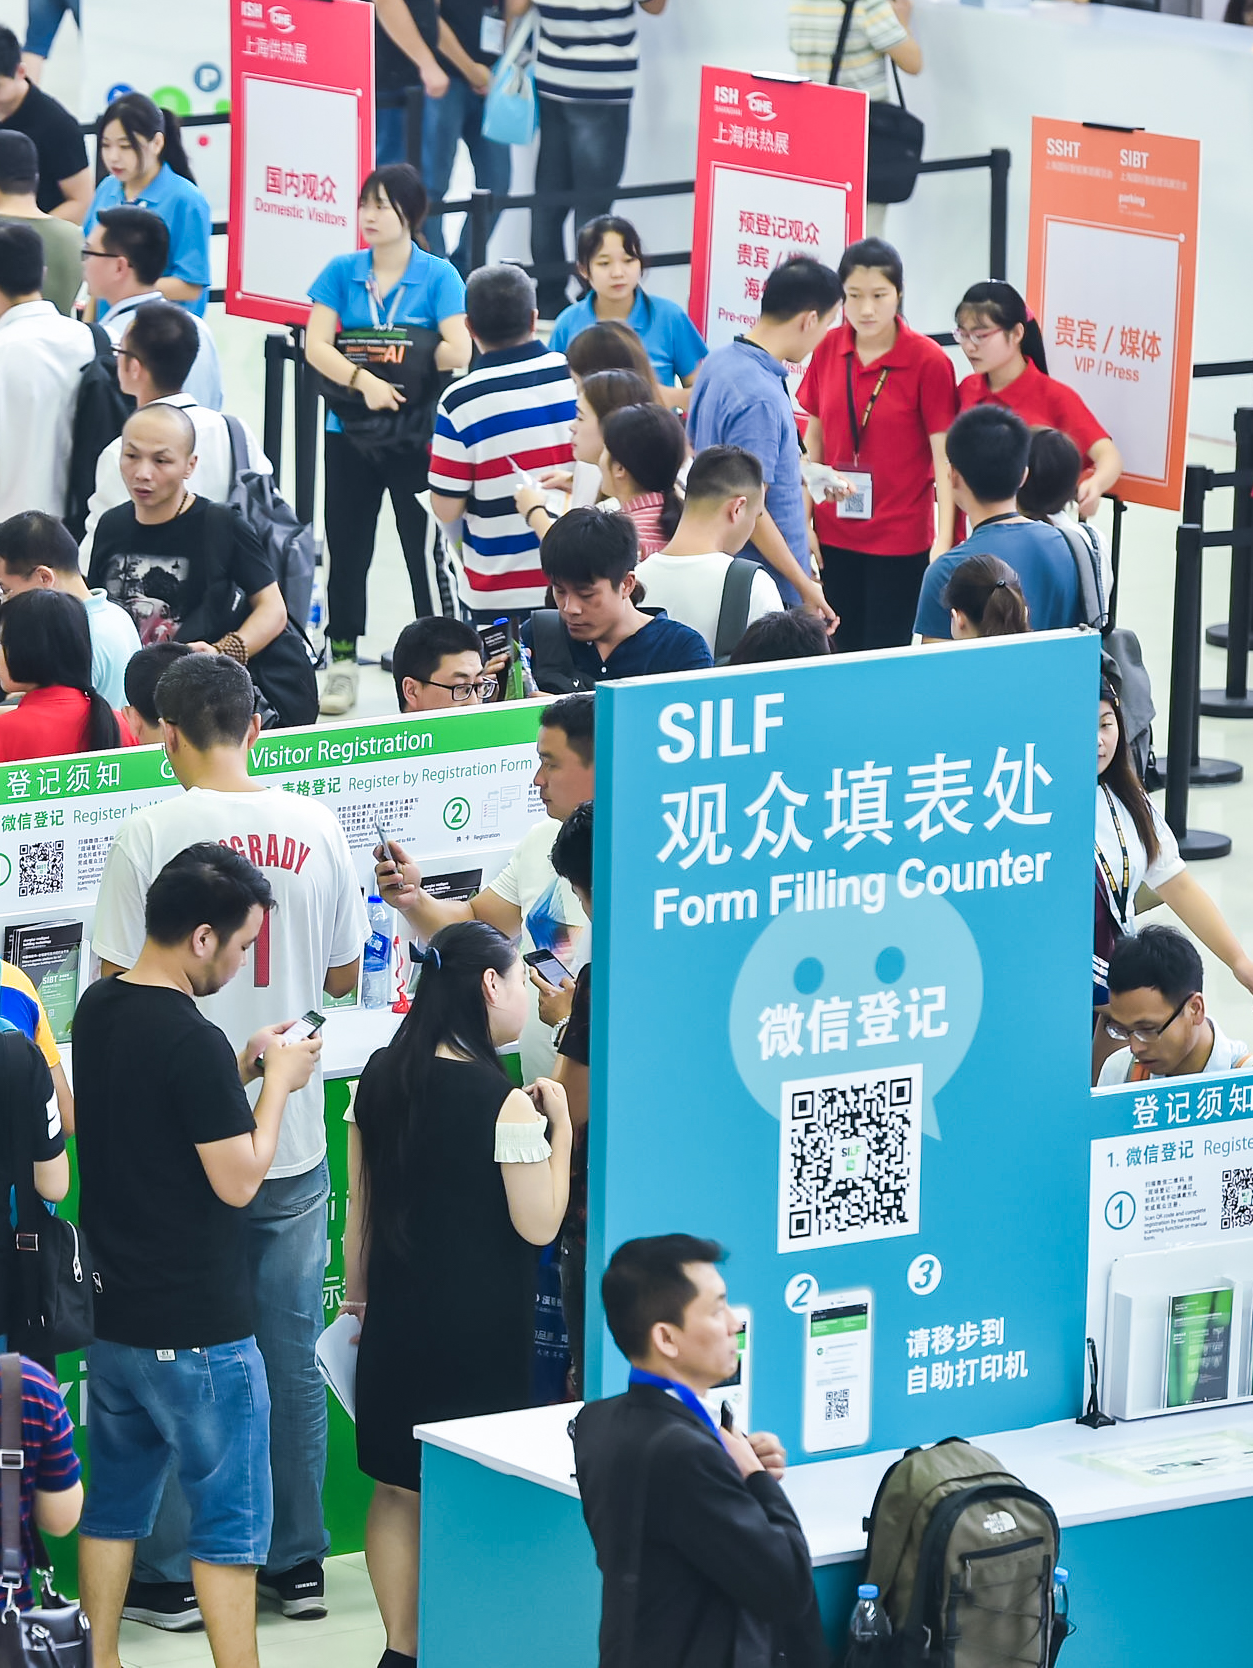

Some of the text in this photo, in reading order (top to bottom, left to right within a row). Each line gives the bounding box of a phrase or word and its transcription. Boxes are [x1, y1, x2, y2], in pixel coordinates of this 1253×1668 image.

[714, 85, 739, 105] ISH
[713, 122, 790, 155] 上海供热展
[1046, 138, 1081, 159] SSHT
[1120, 149, 1149, 169] SIBT
[266, 165, 337, 204] 国内观众
[255, 196, 348, 227] Domestic Visitors
[739, 210, 820, 246] 预登记观众
[737, 243, 770, 270] 贵宾
[1055, 316, 1097, 352] 贵宾
[1119, 325, 1162, 363] 媒体
[1074, 355, 1095, 374] VIP
[1105, 361, 1140, 382] Press
[657, 692, 785, 764] SILF
[250, 731, 433, 769] Visitor Registration
[6, 761, 121, 799] 登记须知
[348, 775, 399, 792] Register
[403, 771, 418, 787] by
[422, 761, 497, 783] Registration
[500, 757, 533, 773] Form
[1, 809, 64, 832] 微信登记
[73, 807, 127, 825] Register
[656, 743, 1053, 870] 观众填表处
[218, 834, 311, 875] GRADY
[654, 848, 1051, 930] Form Filling Counter
[42, 975, 58, 985] SIBT
[757, 985, 949, 1061] 微信登记
[1133, 1083, 1253, 1129] 登记须知
[1107, 1136, 1253, 1168] 1. 微信登记 Registe
[906, 1316, 1005, 1359] 请移步到
[907, 1350, 1028, 1396] 自助打印机
